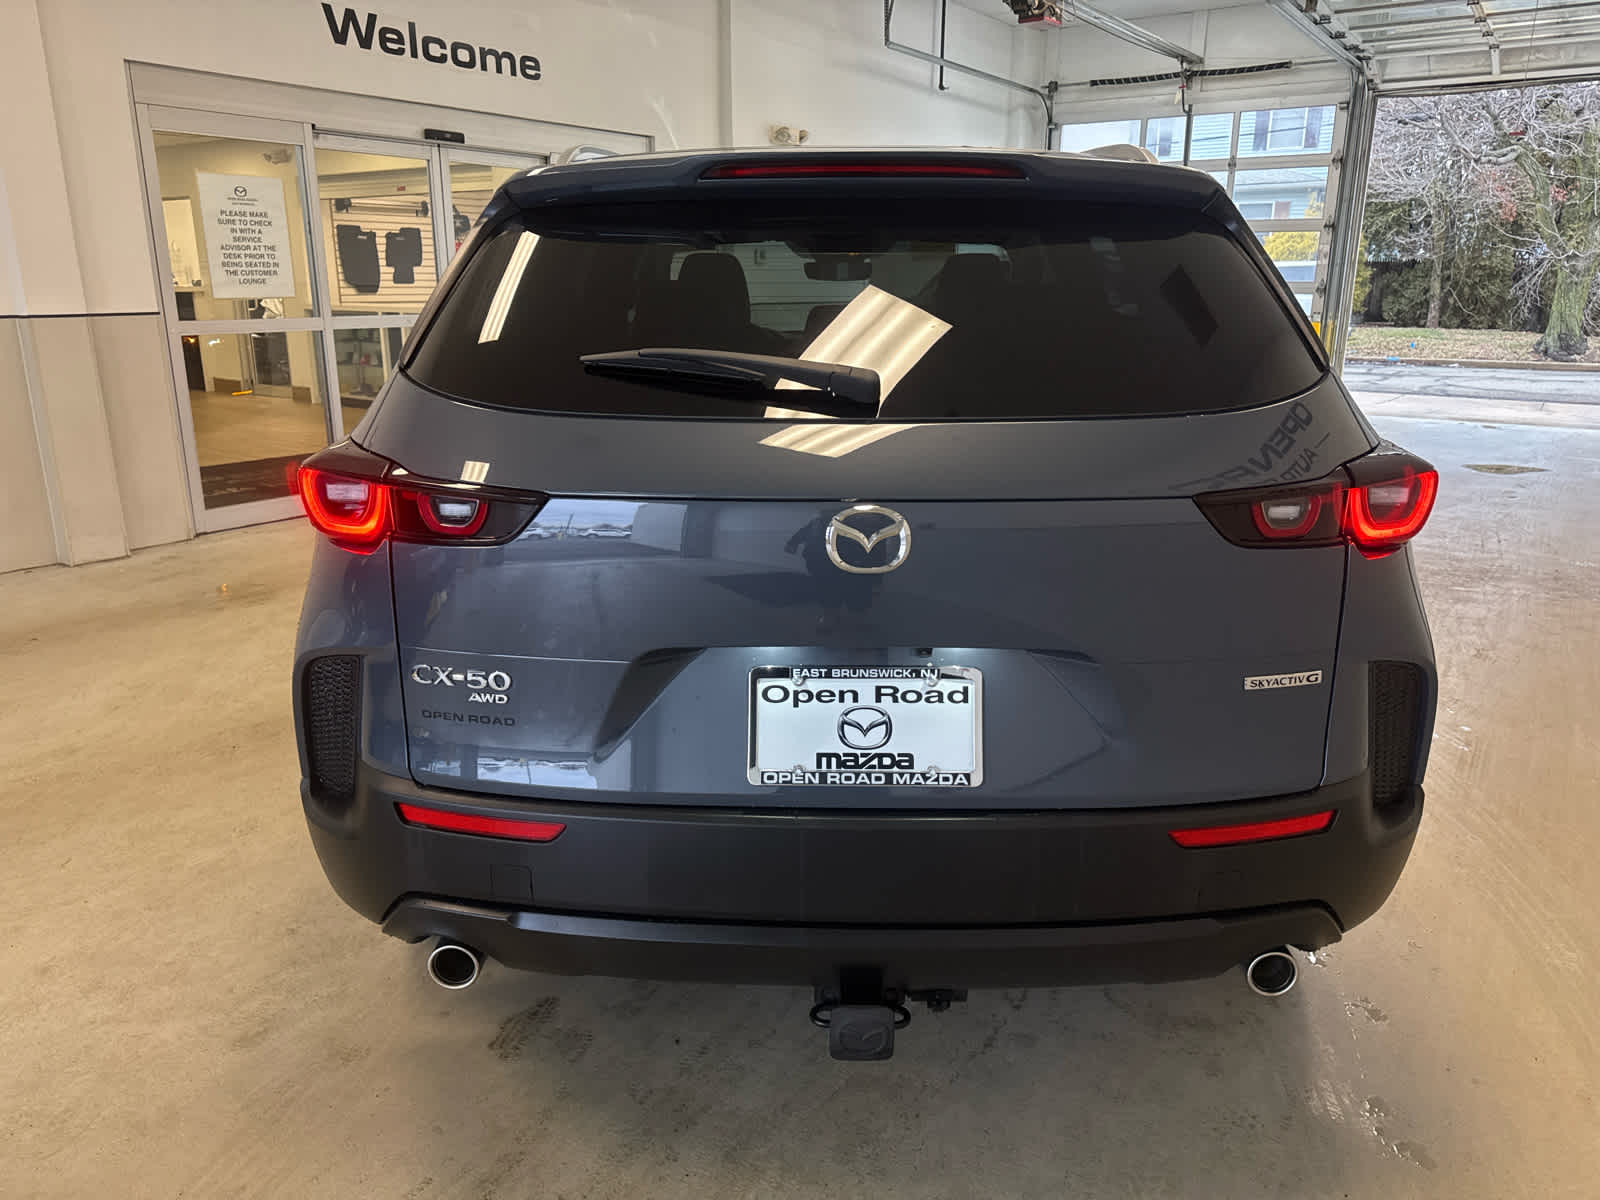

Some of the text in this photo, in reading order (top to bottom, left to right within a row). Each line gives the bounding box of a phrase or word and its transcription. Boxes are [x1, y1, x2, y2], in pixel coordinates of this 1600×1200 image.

[321, 2, 541, 81] Welcome
[220, 209, 268, 219] PLEASE MAKE
[217, 218, 236, 226] SURE
[249, 219, 272, 227] CHECK
[220, 244, 251, 252] ADVISOR
[253, 244, 262, 252] AT
[223, 252, 242, 260] DESK
[245, 261, 271, 269] SEATED
[411, 664, 512, 691] CX-50
[792, 668, 938, 679] EAST BRUNSWICK, NJ
[468, 692, 508, 704] AWD
[761, 685, 969, 708] Open Road
[422, 709, 516, 726] OPEN ROAD
[816, 752, 915, 770] mazda
[763, 772, 969, 785] OPEN ROAD MAZDA
